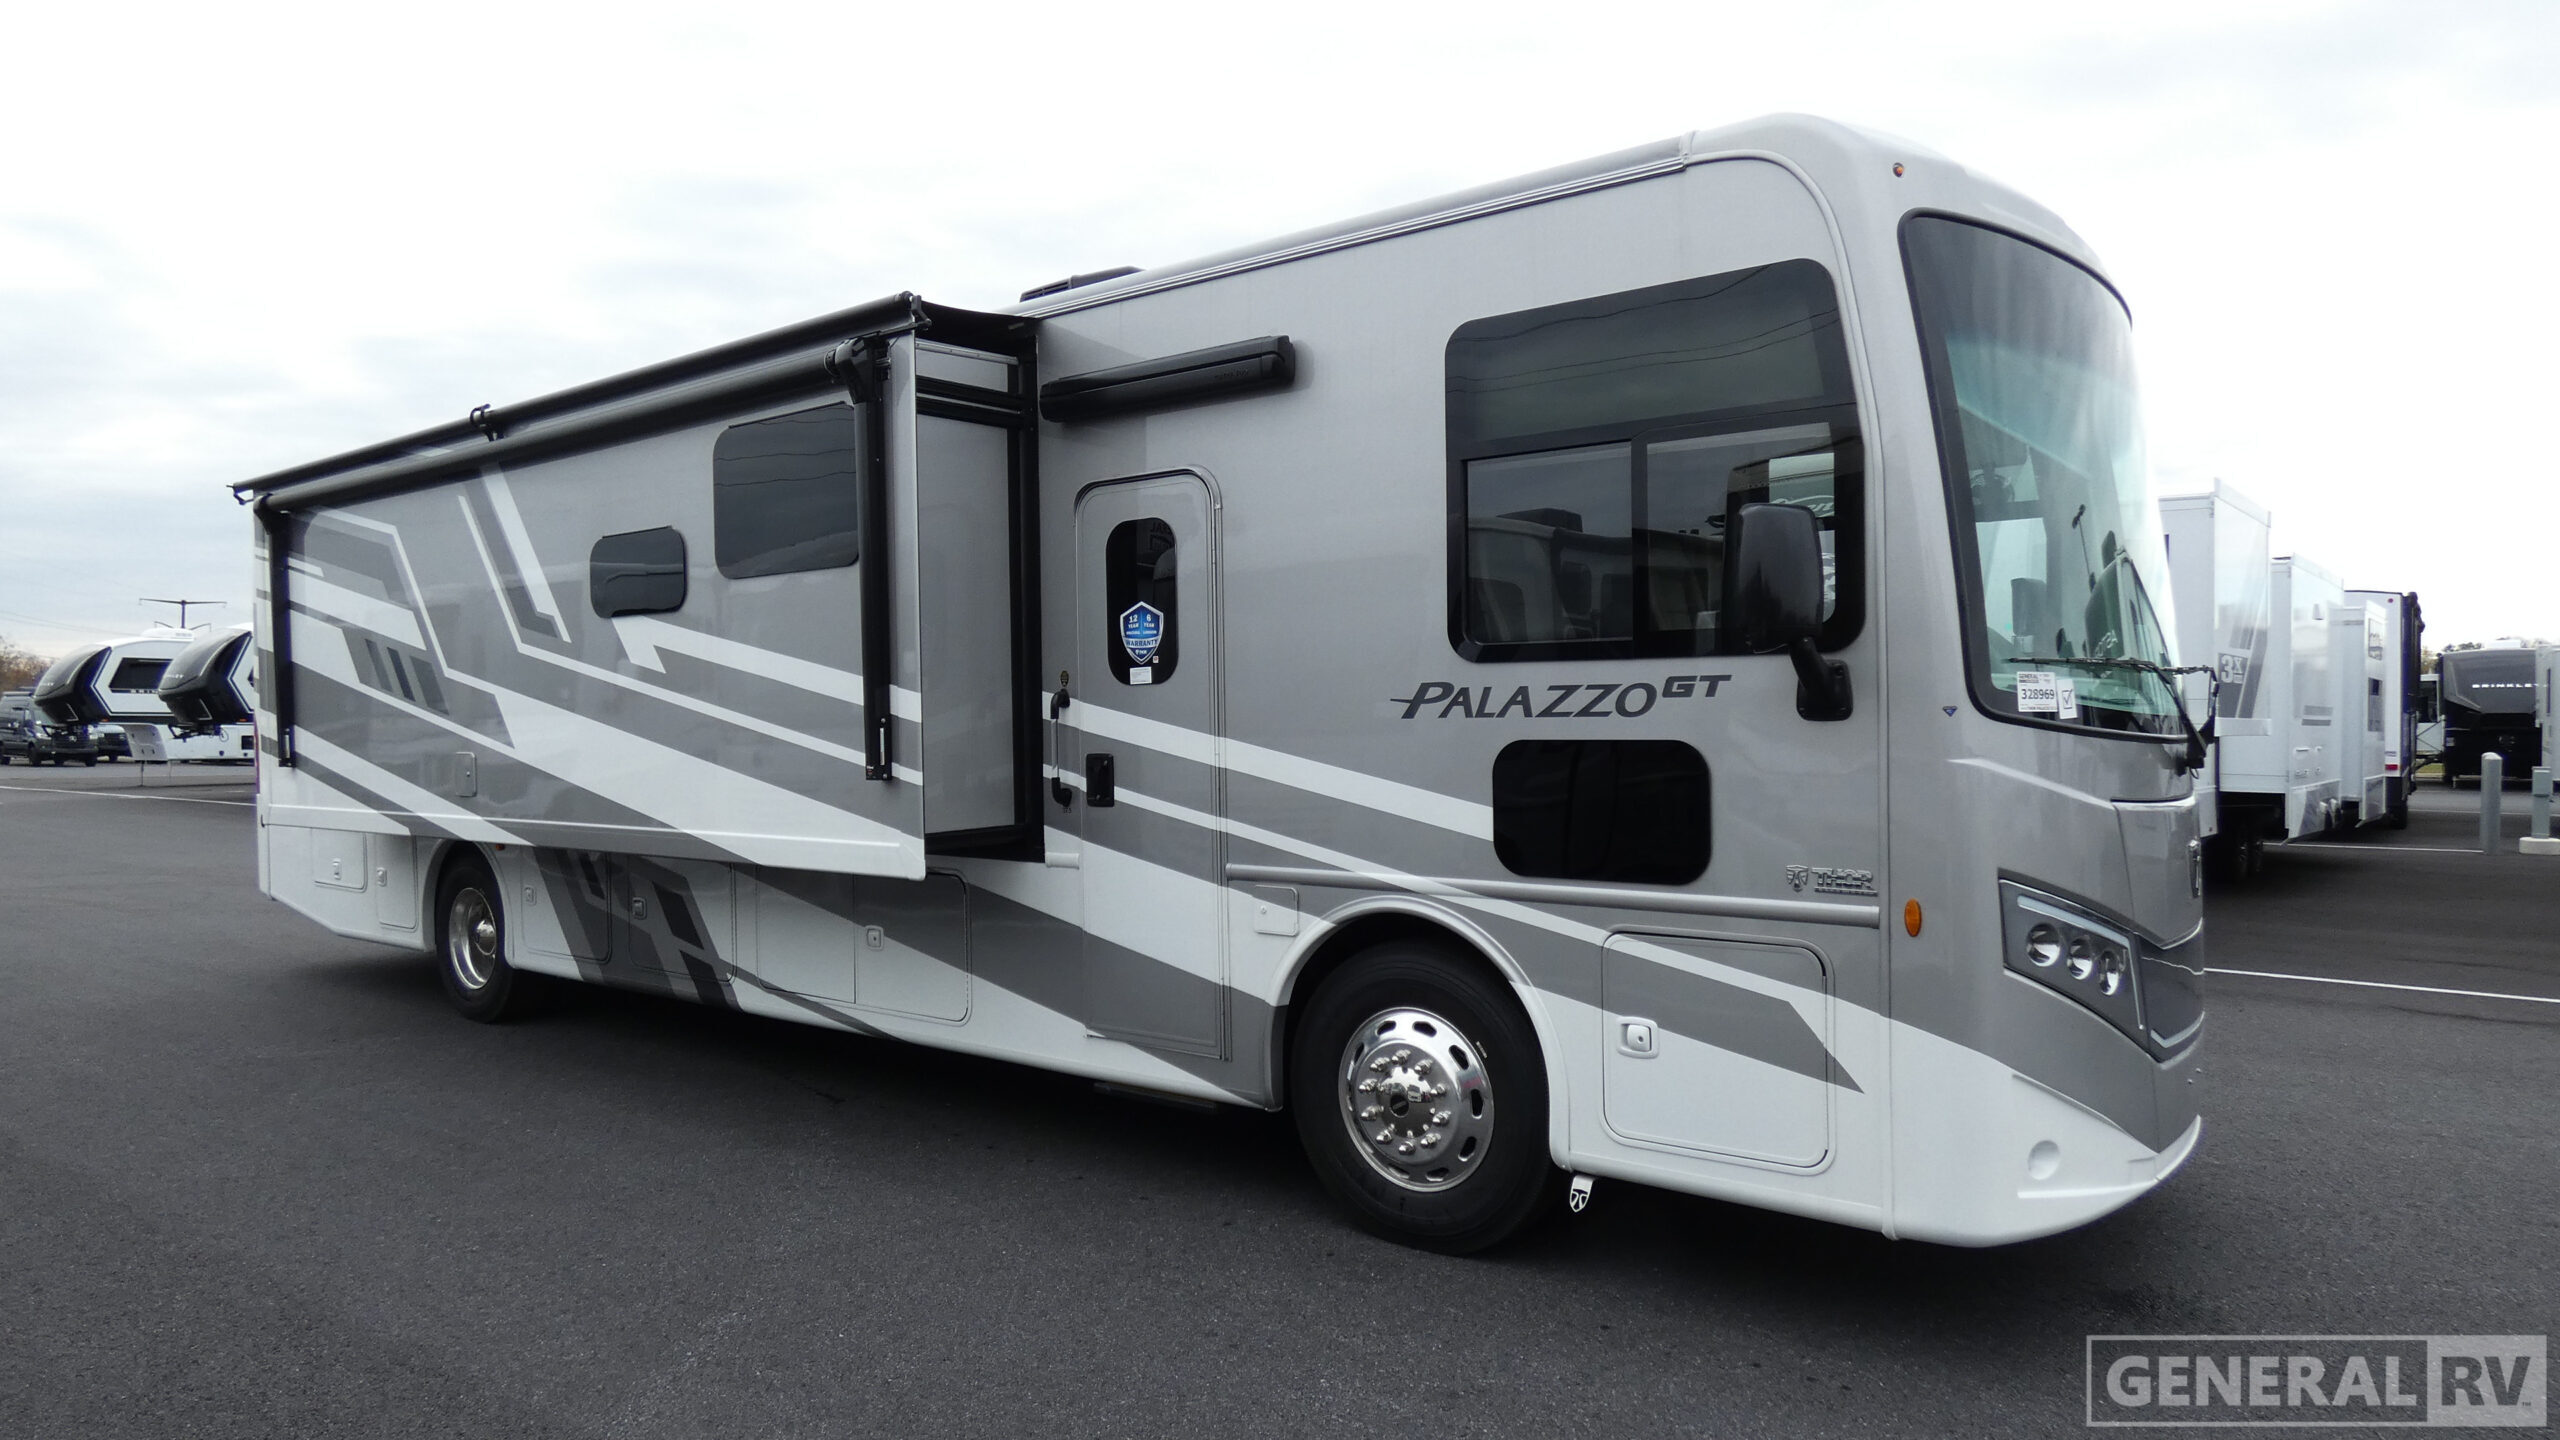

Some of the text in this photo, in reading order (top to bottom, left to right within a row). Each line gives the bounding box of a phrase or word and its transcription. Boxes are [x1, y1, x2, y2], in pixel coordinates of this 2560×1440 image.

[1129, 614, 1138, 623] 12
[1126, 639, 1158, 647] WARRANTY
[1390, 674, 1732, 719] PALAZZO GT
[2021, 688, 2055, 699] 328969
[1811, 867, 1873, 889] THOR
